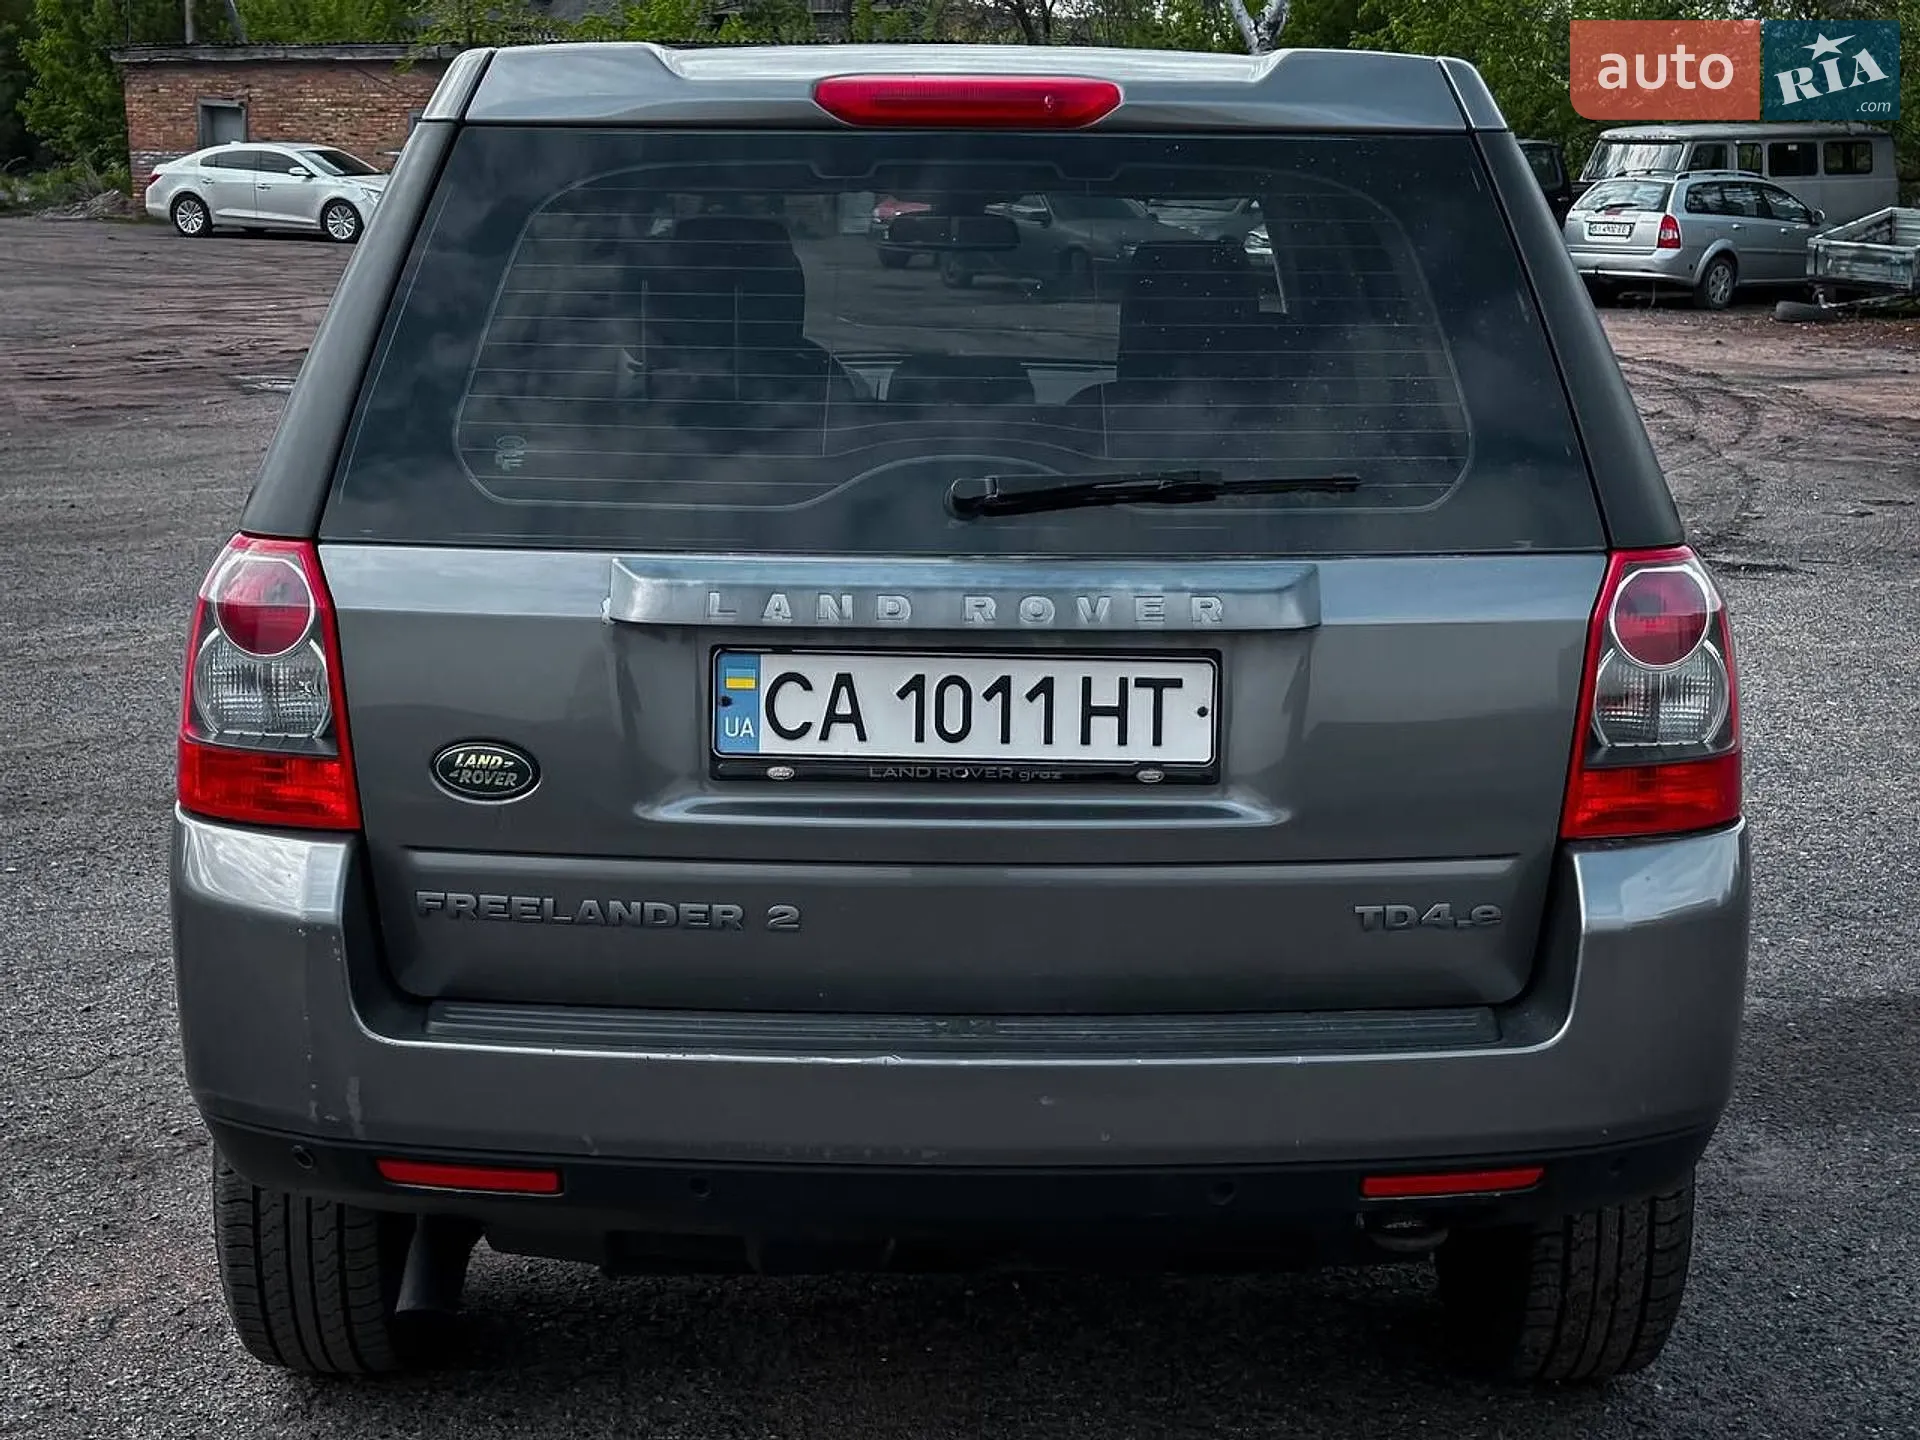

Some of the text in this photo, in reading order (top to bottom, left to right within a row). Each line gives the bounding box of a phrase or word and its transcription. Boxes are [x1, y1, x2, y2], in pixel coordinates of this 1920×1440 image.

[707, 591, 1224, 625] LAND ROVER
[764, 671, 1184, 747] CA 1011 HT
[724, 717, 754, 738] UA
[455, 752, 504, 769] LAND
[458, 769, 518, 788] ROVER
[869, 766, 931, 779] LAND
[936, 766, 1013, 779] ROVER
[415, 890, 801, 931] FREELANDER 2
